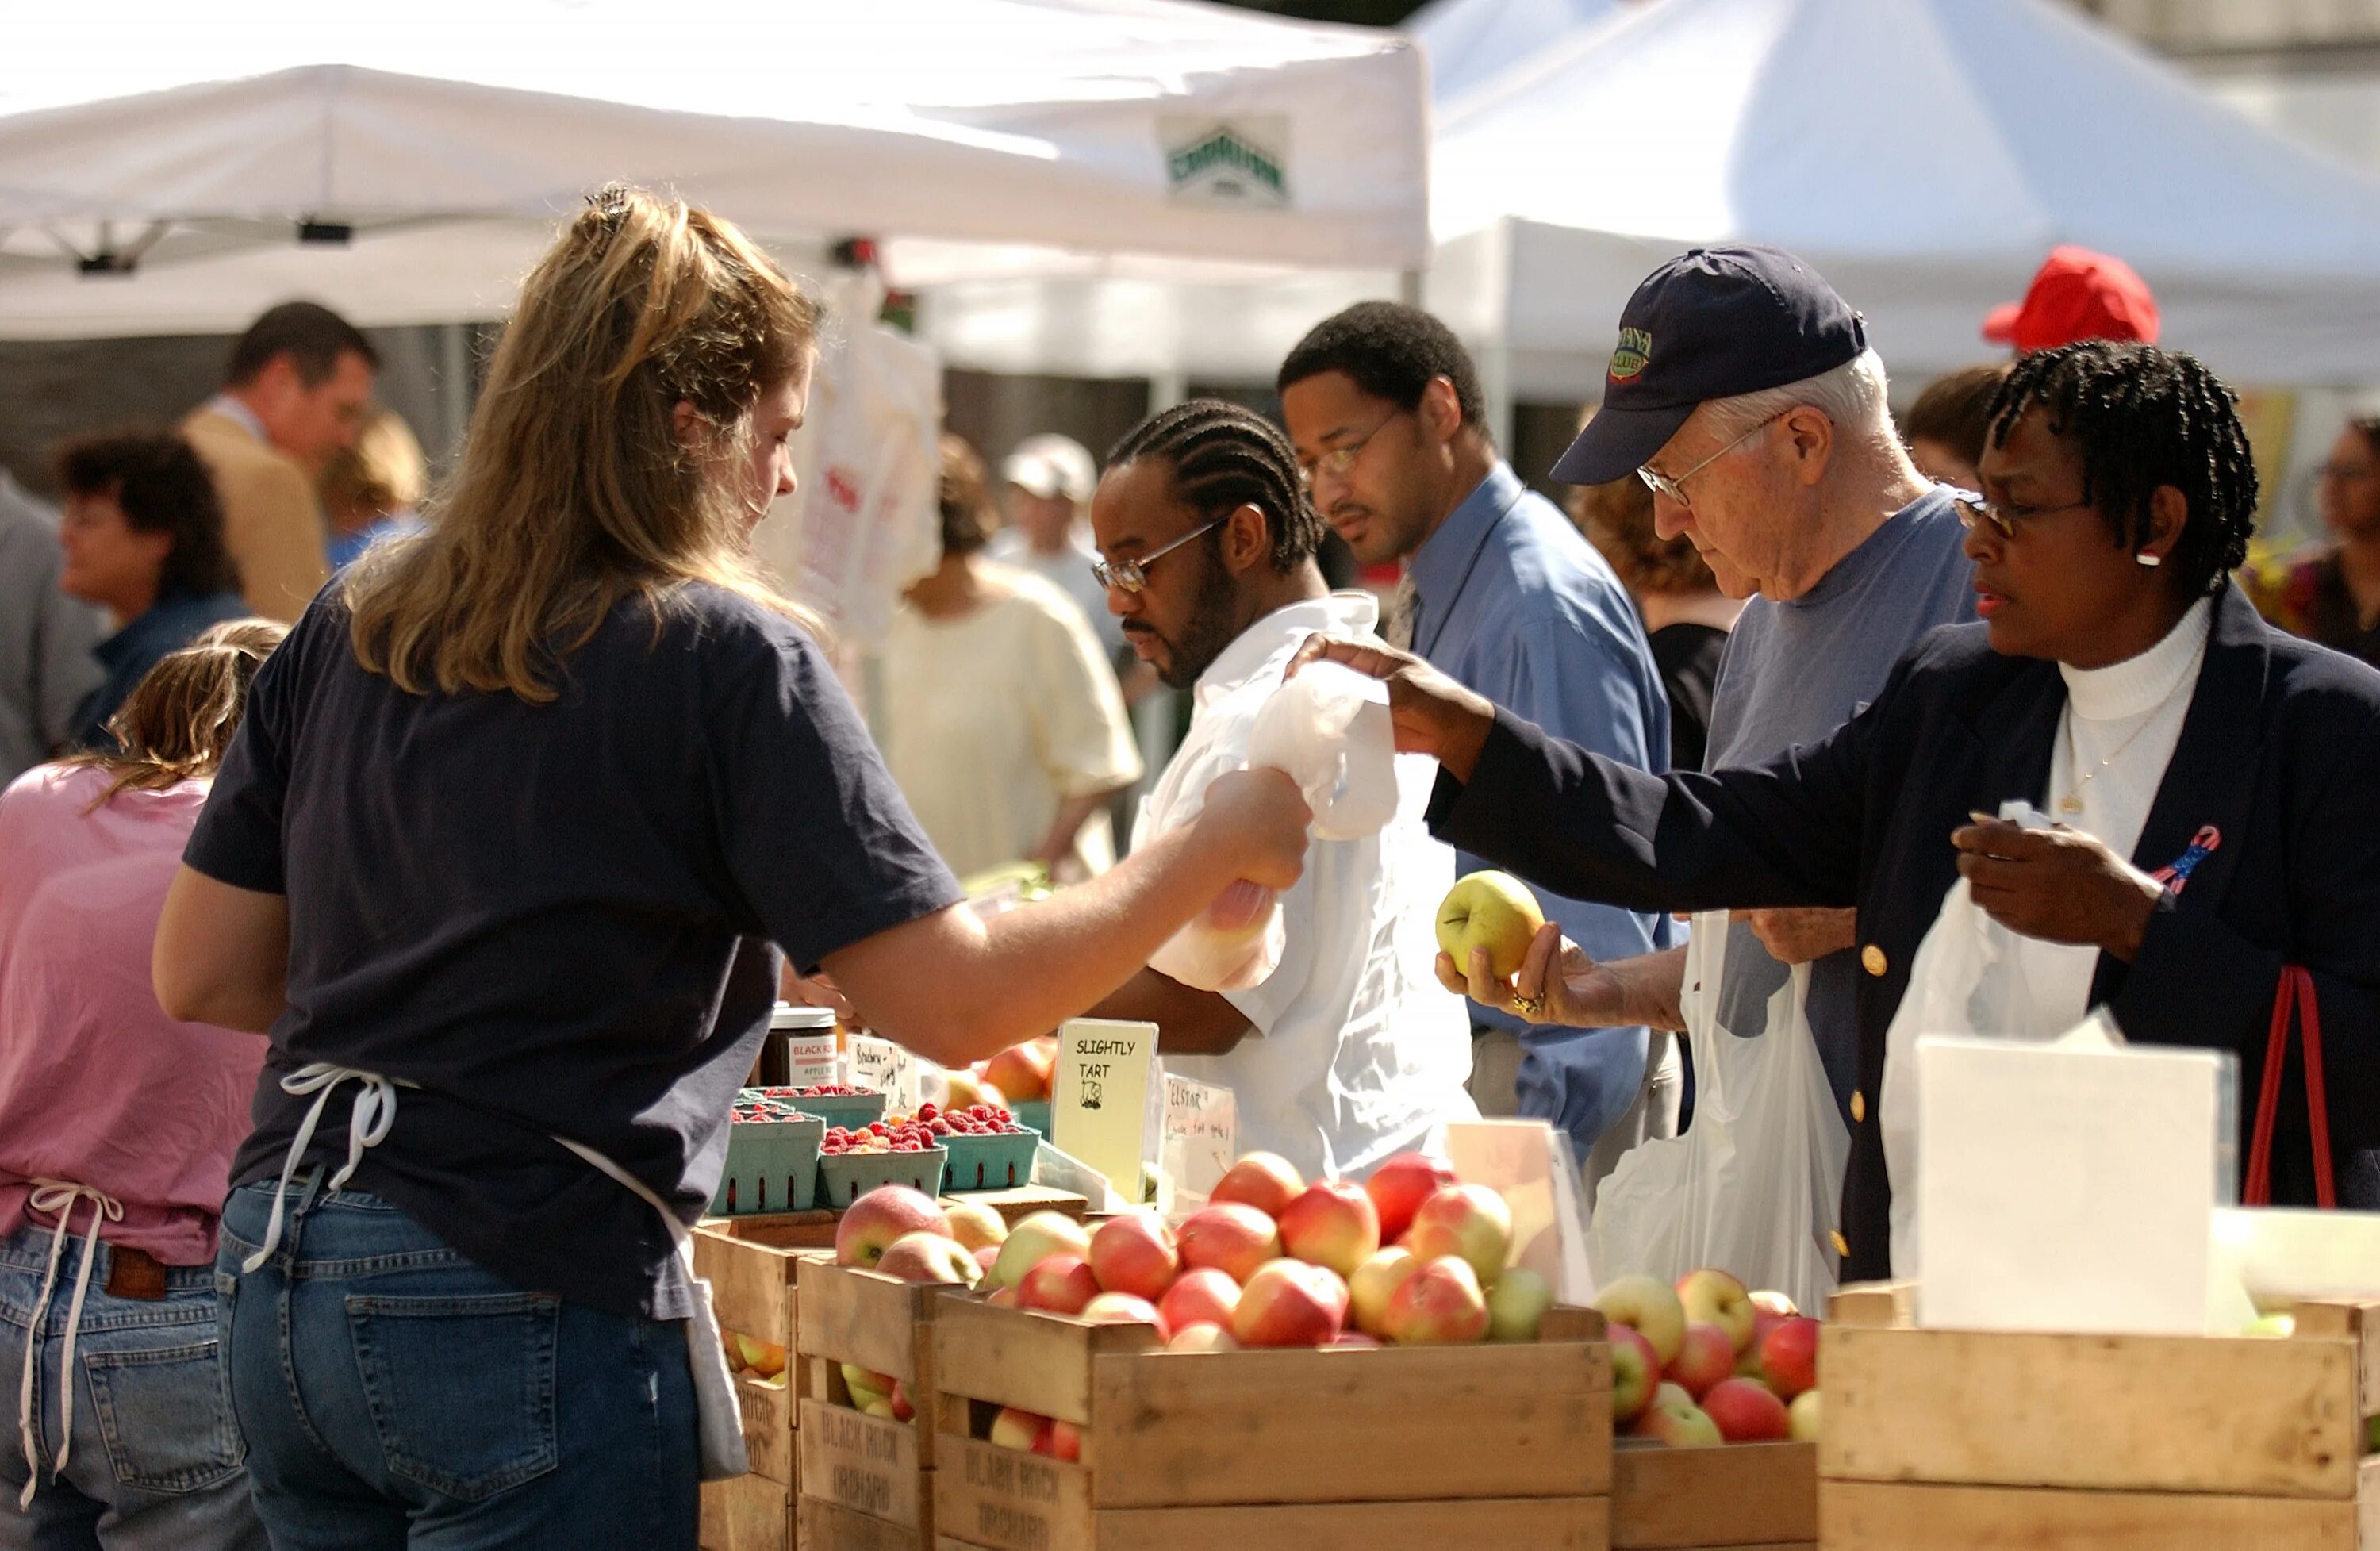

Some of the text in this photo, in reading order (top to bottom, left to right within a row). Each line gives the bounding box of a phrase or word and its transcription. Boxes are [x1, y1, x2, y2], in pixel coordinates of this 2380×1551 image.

[793, 1045, 822, 1055] BLACK
[1076, 1040, 1136, 1056] SLIGHTLY
[804, 1067, 825, 1076] APPLE
[1079, 1064, 1111, 1078] TART
[822, 1410, 898, 1466] BLACK ROCK
[833, 1465, 891, 1512] ORCHARD
